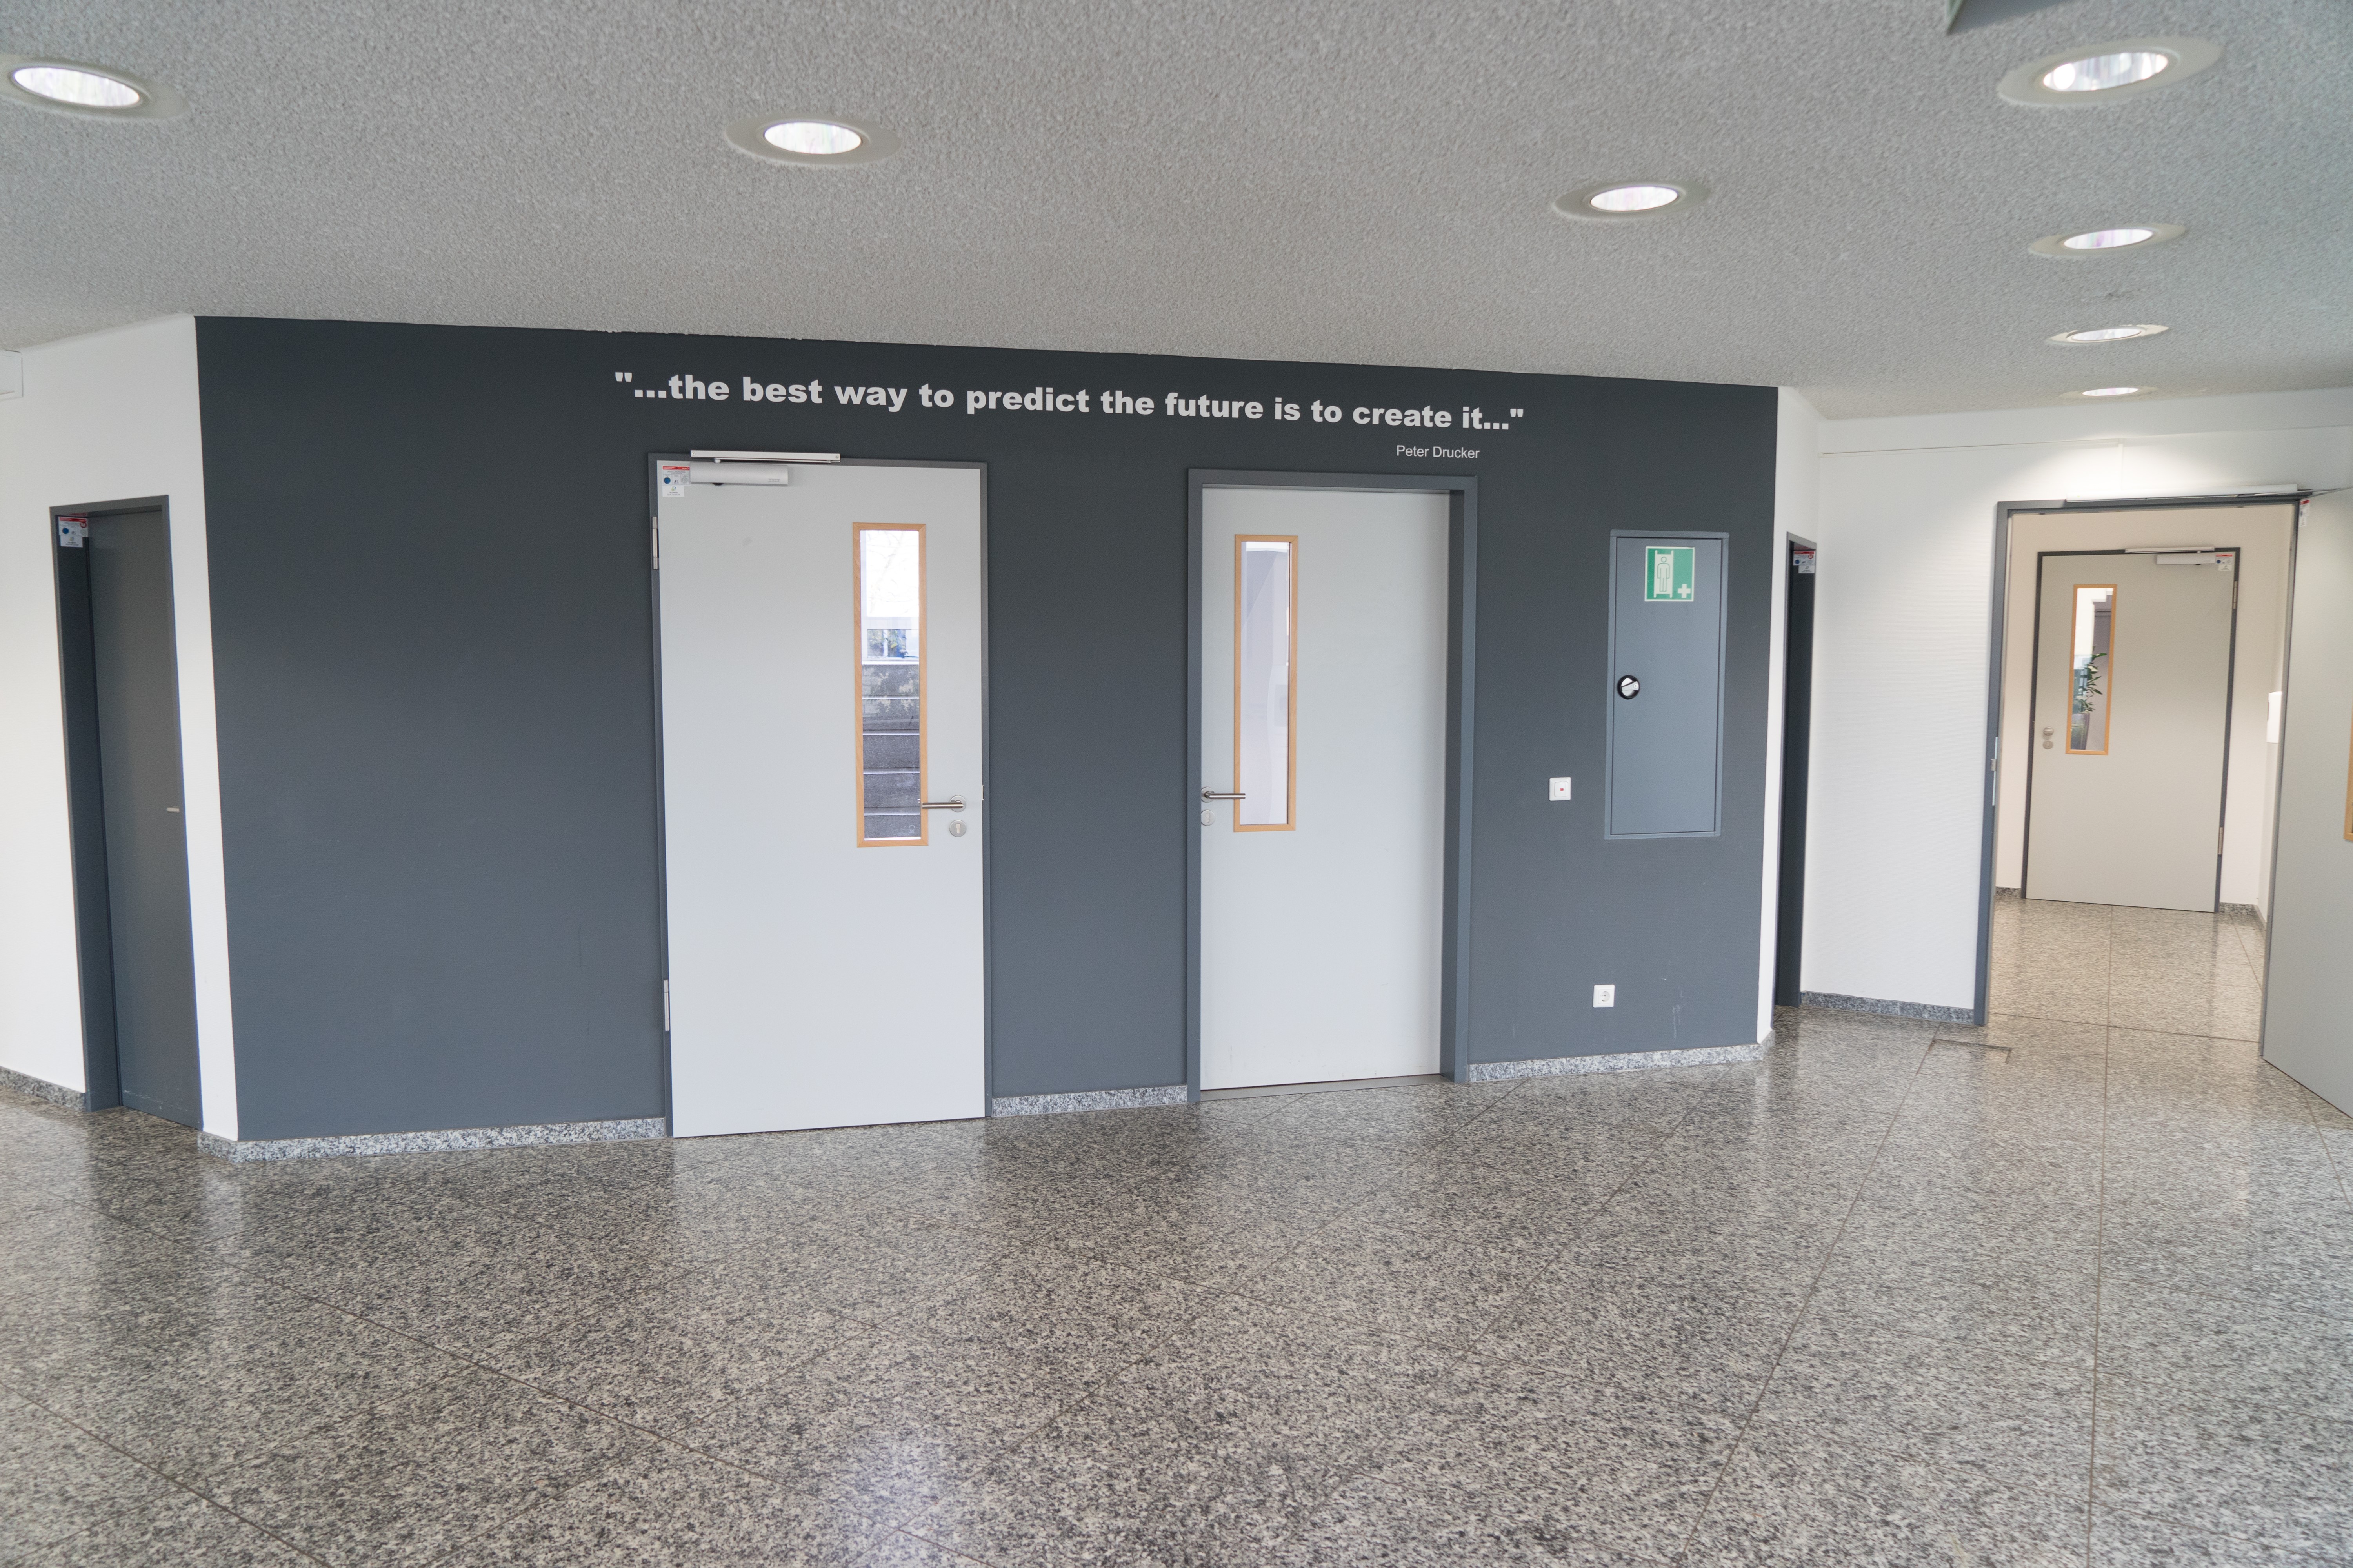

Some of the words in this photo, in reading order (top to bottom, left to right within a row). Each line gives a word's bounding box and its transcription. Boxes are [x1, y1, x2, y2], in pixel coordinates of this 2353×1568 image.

[615, 372, 730, 401] "...the
[742, 377, 823, 404] best
[833, 386, 908, 413] way
[918, 383, 955, 408] to
[966, 387, 1090, 415] predict
[1100, 390, 1155, 415] the
[1164, 392, 1264, 419] future
[1274, 397, 1301, 421] is
[1310, 400, 1343, 423] to
[1352, 405, 1452, 428] create
[1462, 406, 1524, 431] it..."
[1397, 445, 1429, 457] Peter
[1433, 446, 1480, 459] Drucker
